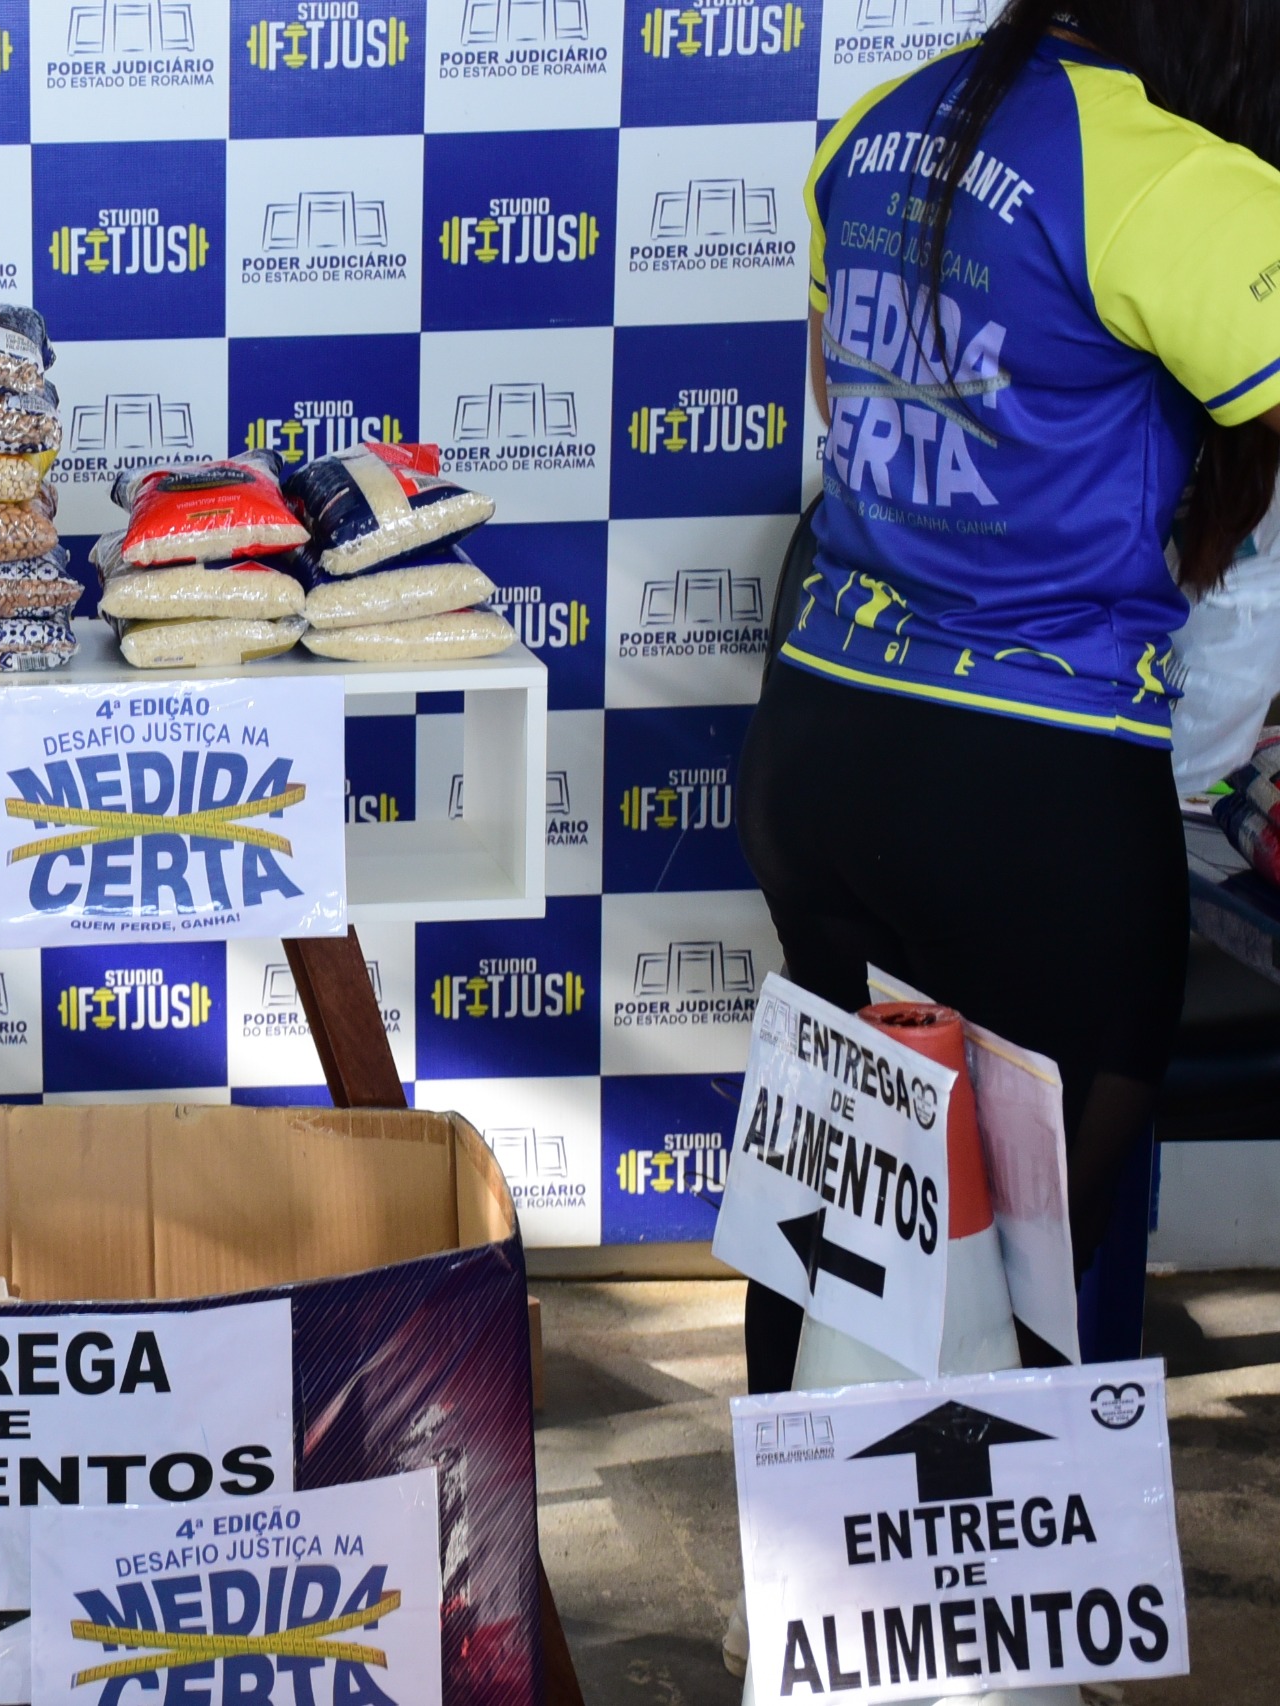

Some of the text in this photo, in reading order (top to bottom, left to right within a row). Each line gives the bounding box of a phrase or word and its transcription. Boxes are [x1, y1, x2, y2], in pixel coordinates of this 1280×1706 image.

[298, 1, 358, 20] STUDIO
[440, 44, 607, 66] PODER JUDICIÁRIO
[440, 62, 606, 78] DO ESTADO DE RORAIMA
[99, 208, 158, 226] STUDIO
[490, 198, 549, 216] STUDIO
[630, 237, 796, 260] PODER JUDICIÁRIO
[840, 220, 990, 294] DESAFIO JUSÇA NA
[629, 255, 795, 272] DO ESTADO DE RORAIMA
[294, 400, 353, 418] STUDIO
[679, 389, 738, 406] STUDIO
[129, 692, 210, 721] EDIÇÃO
[42, 722, 270, 757] DESAFIO JUSTIÇA NA
[6, 750, 293, 830] MEDIDA
[29, 832, 305, 917] CERTA
[70, 912, 241, 932] QUEM PERDE, GANHA!
[105, 969, 163, 985] STUDIO
[480, 958, 536, 974] STUDIO
[798, 1012, 911, 1119] ENTREGA
[830, 1088, 856, 1122] DE
[742, 1085, 938, 1255] ALIMENTOS
[175, 1505, 301, 1540] 4ª EDIÇÃO
[844, 1494, 1096, 1564] ENTREGA
[115, 1534, 365, 1578] DESAFIO JUSTIÇA NA
[935, 1563, 986, 1589] DE
[74, 1565, 389, 1651] MEDIDA
[780, 1584, 1169, 1697] ALIMENTOS
